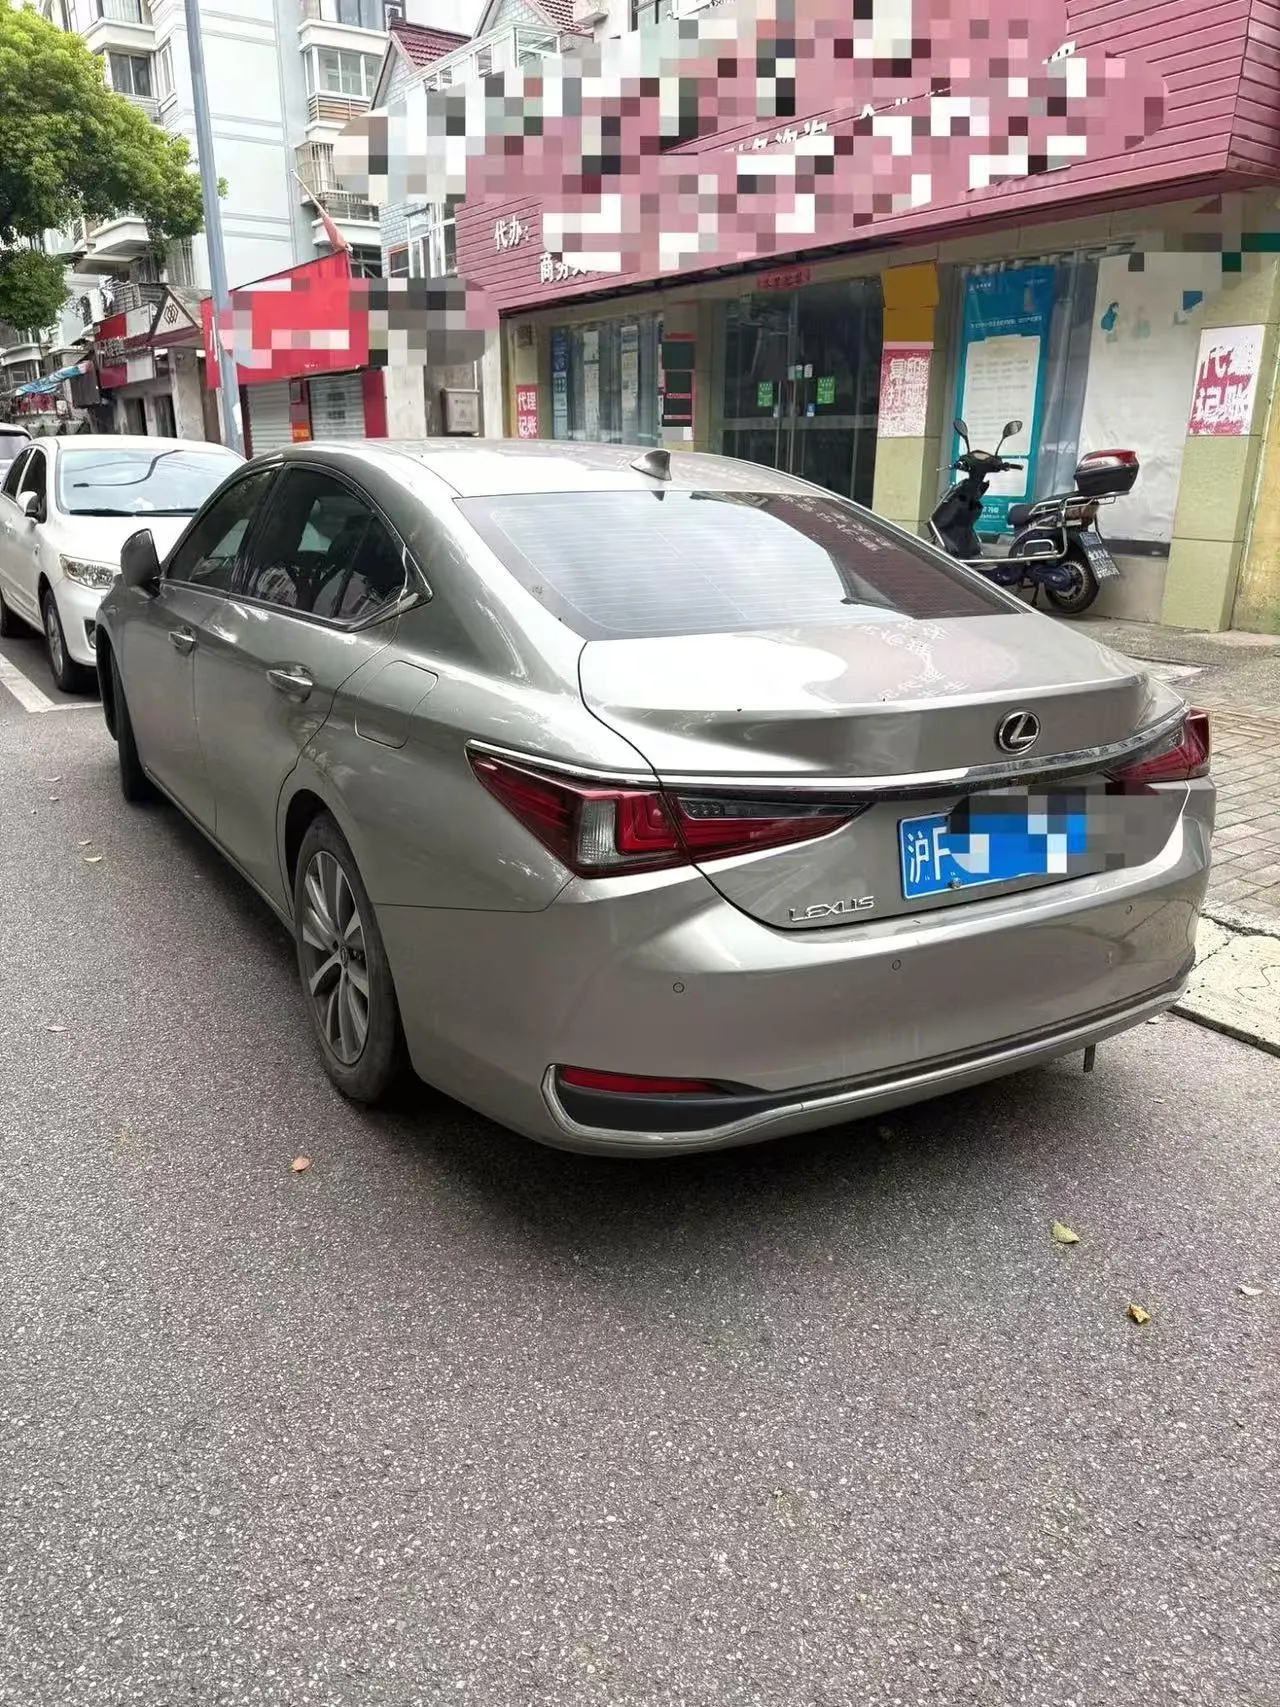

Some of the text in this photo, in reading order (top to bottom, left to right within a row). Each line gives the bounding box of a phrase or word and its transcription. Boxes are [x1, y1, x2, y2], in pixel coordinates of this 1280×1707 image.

[518, 391, 537, 411] 代理
[518, 415, 538, 437] 记账
[789, 895, 875, 922] LEXUS
